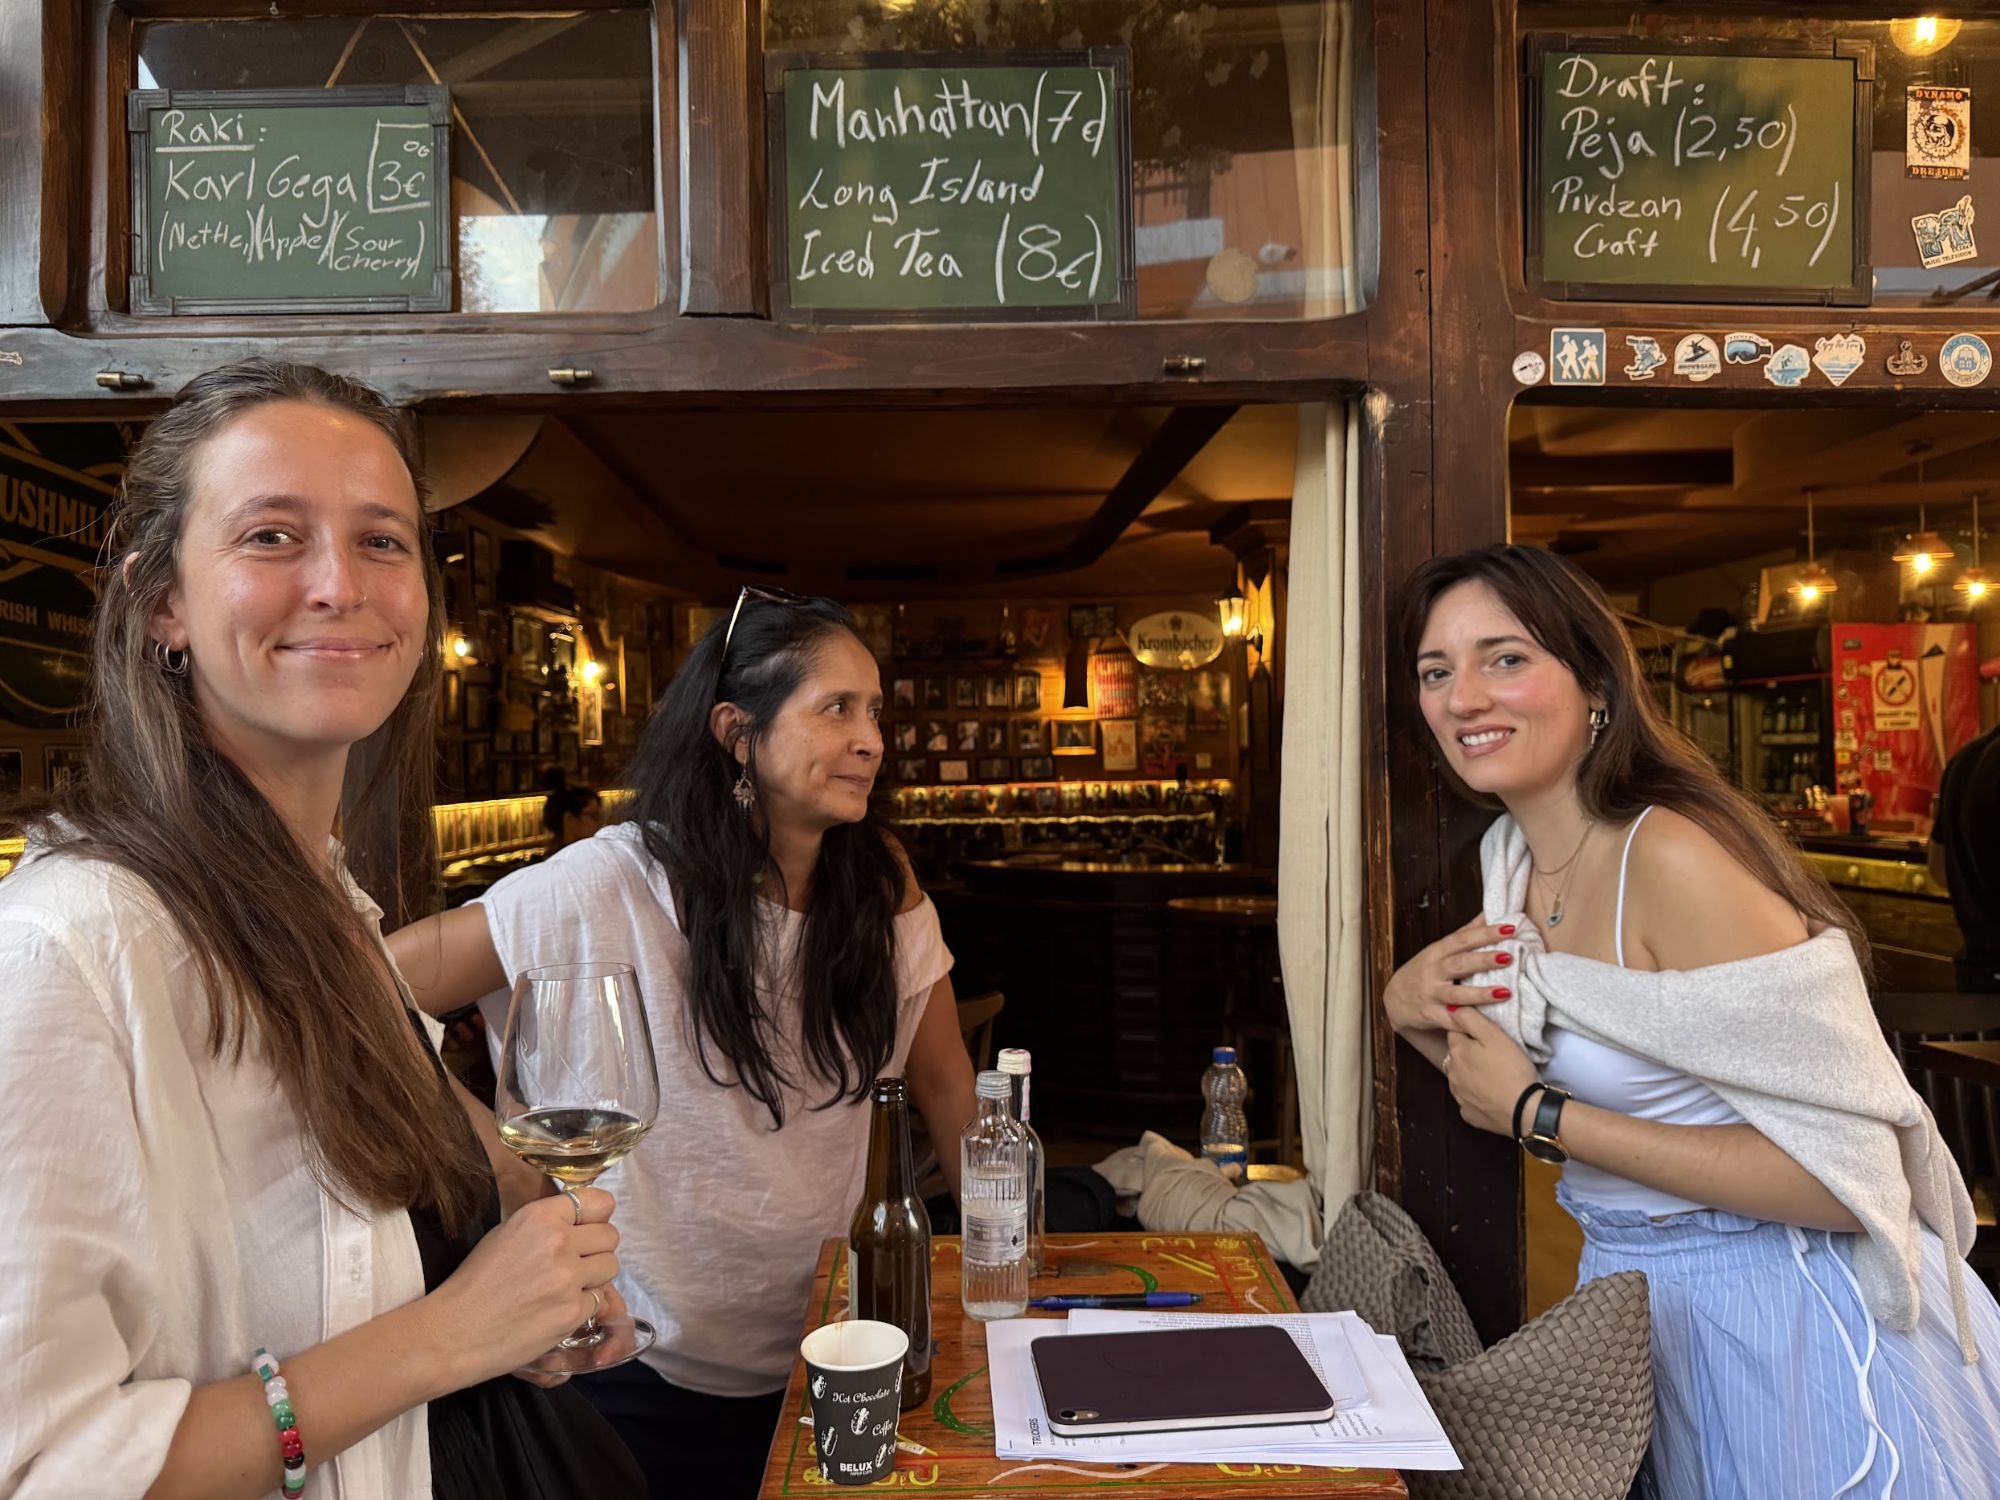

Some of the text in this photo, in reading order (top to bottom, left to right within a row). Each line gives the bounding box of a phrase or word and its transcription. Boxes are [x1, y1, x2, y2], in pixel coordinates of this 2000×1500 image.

[1557, 54, 1706, 107] Draft:
[1915, 89, 1963, 101] DYNAMO
[809, 77, 1032, 149] Manhattan
[1560, 103, 1798, 179] Peja (2,50)
[1911, 166, 1965, 178] DRESDEN
[799, 158, 1045, 226] Long Island
[796, 229, 876, 282] Iced
[893, 227, 964, 279] Tea
[1573, 222, 1659, 259] Craft
[0, 472, 112, 548] USHMIL
[0, 599, 38, 626] RISH
[1137, 632, 1214, 652] Krombacher
[832, 1388, 890, 1404] Hot Chocolate
[840, 1461, 873, 1472] BELUX
